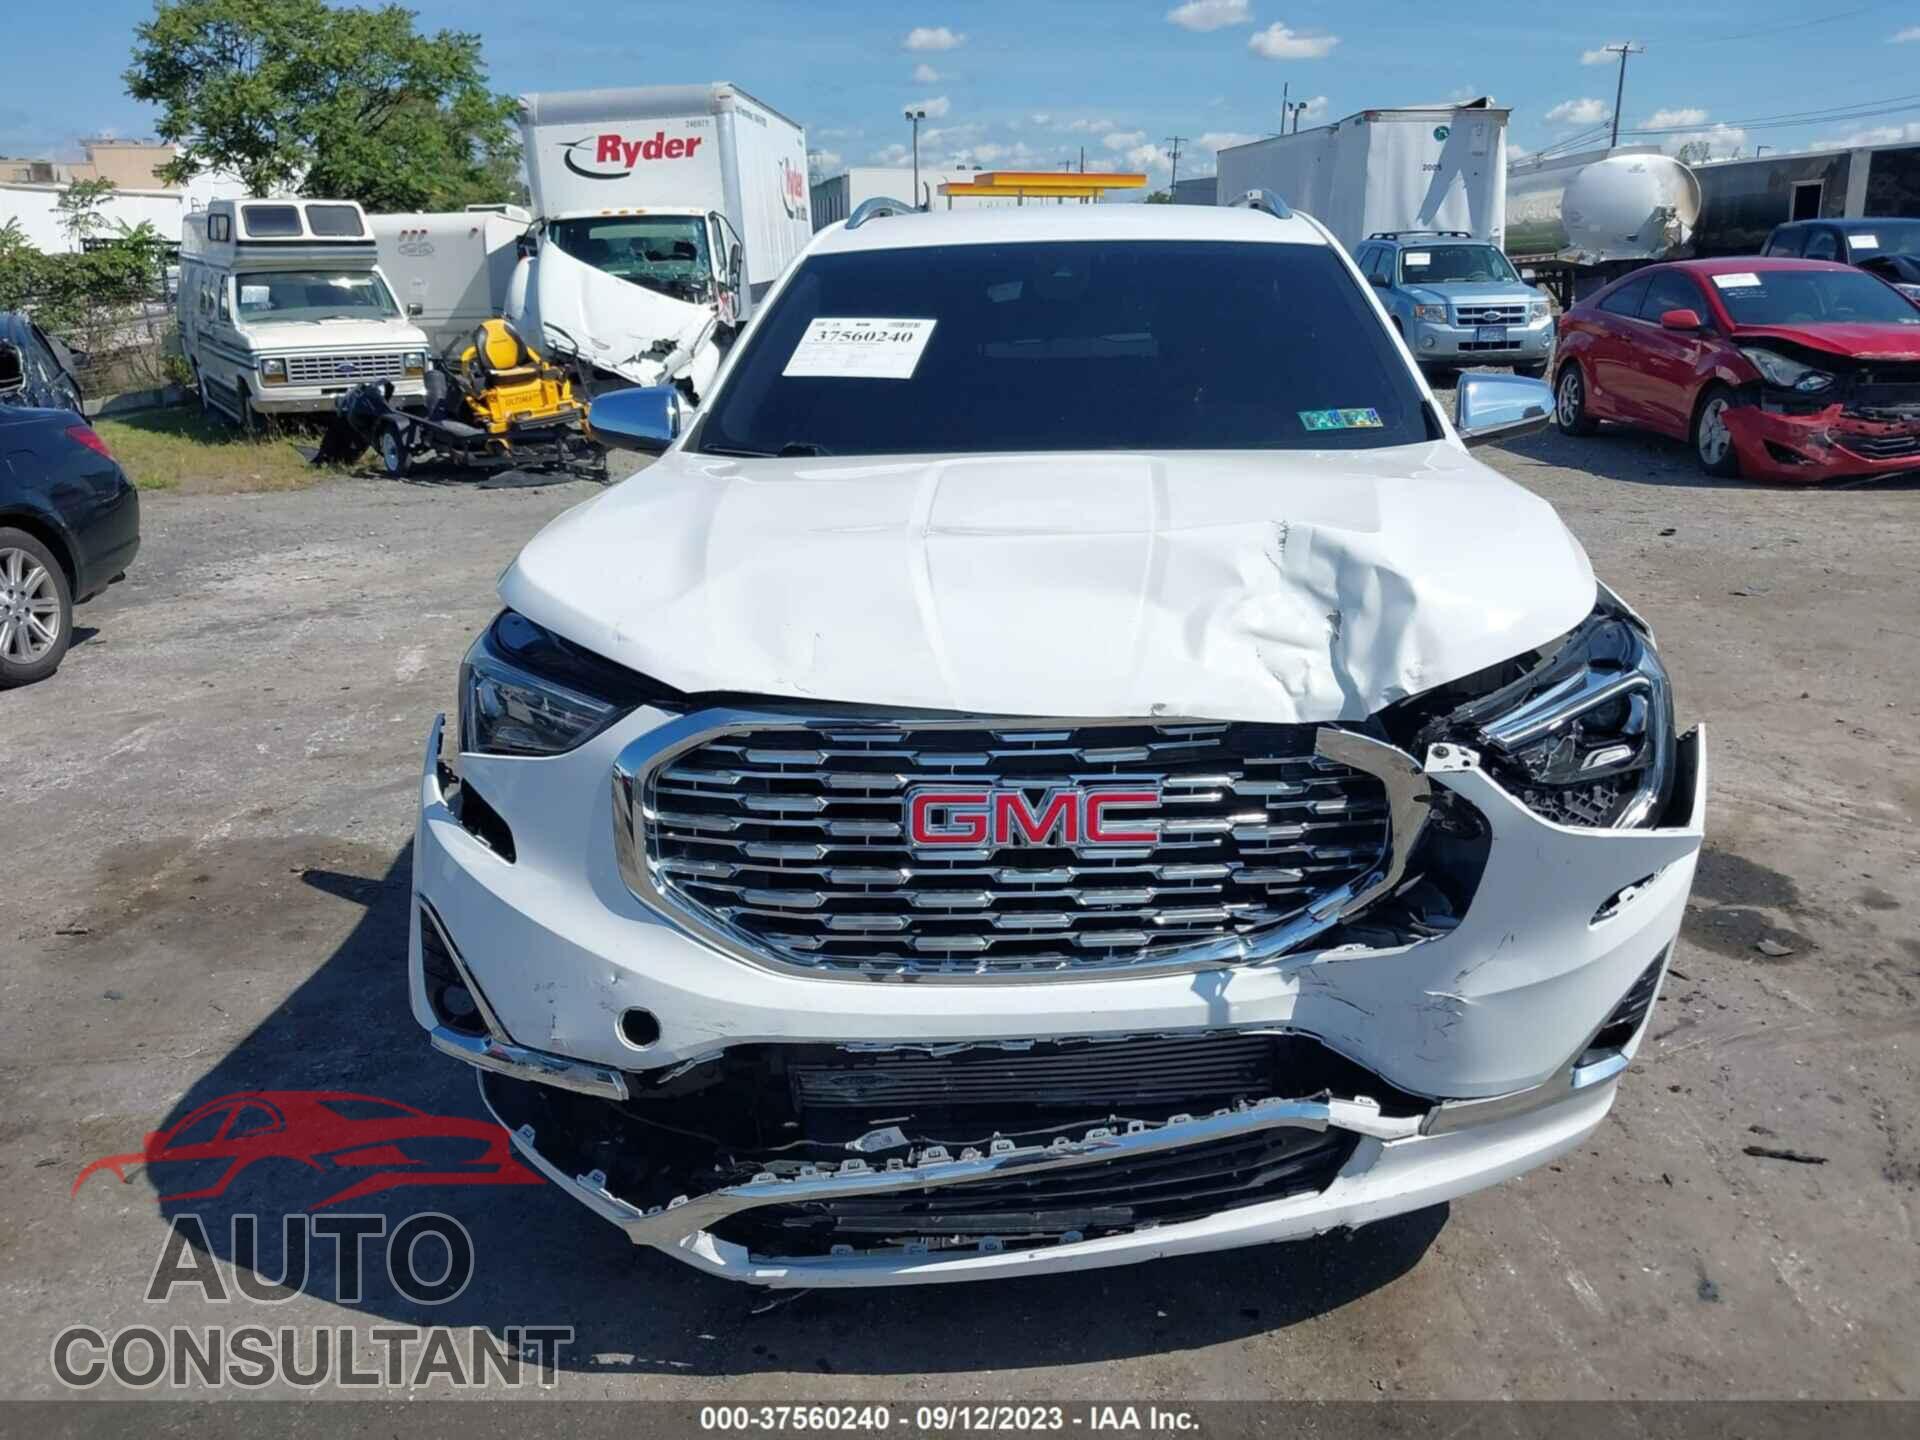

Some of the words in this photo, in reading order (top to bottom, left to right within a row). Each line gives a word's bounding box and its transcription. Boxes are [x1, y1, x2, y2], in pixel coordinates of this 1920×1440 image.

[597, 131, 702, 168] Ryder
[814, 330, 914, 343] 37560240
[905, 785, 1162, 847] GMC
